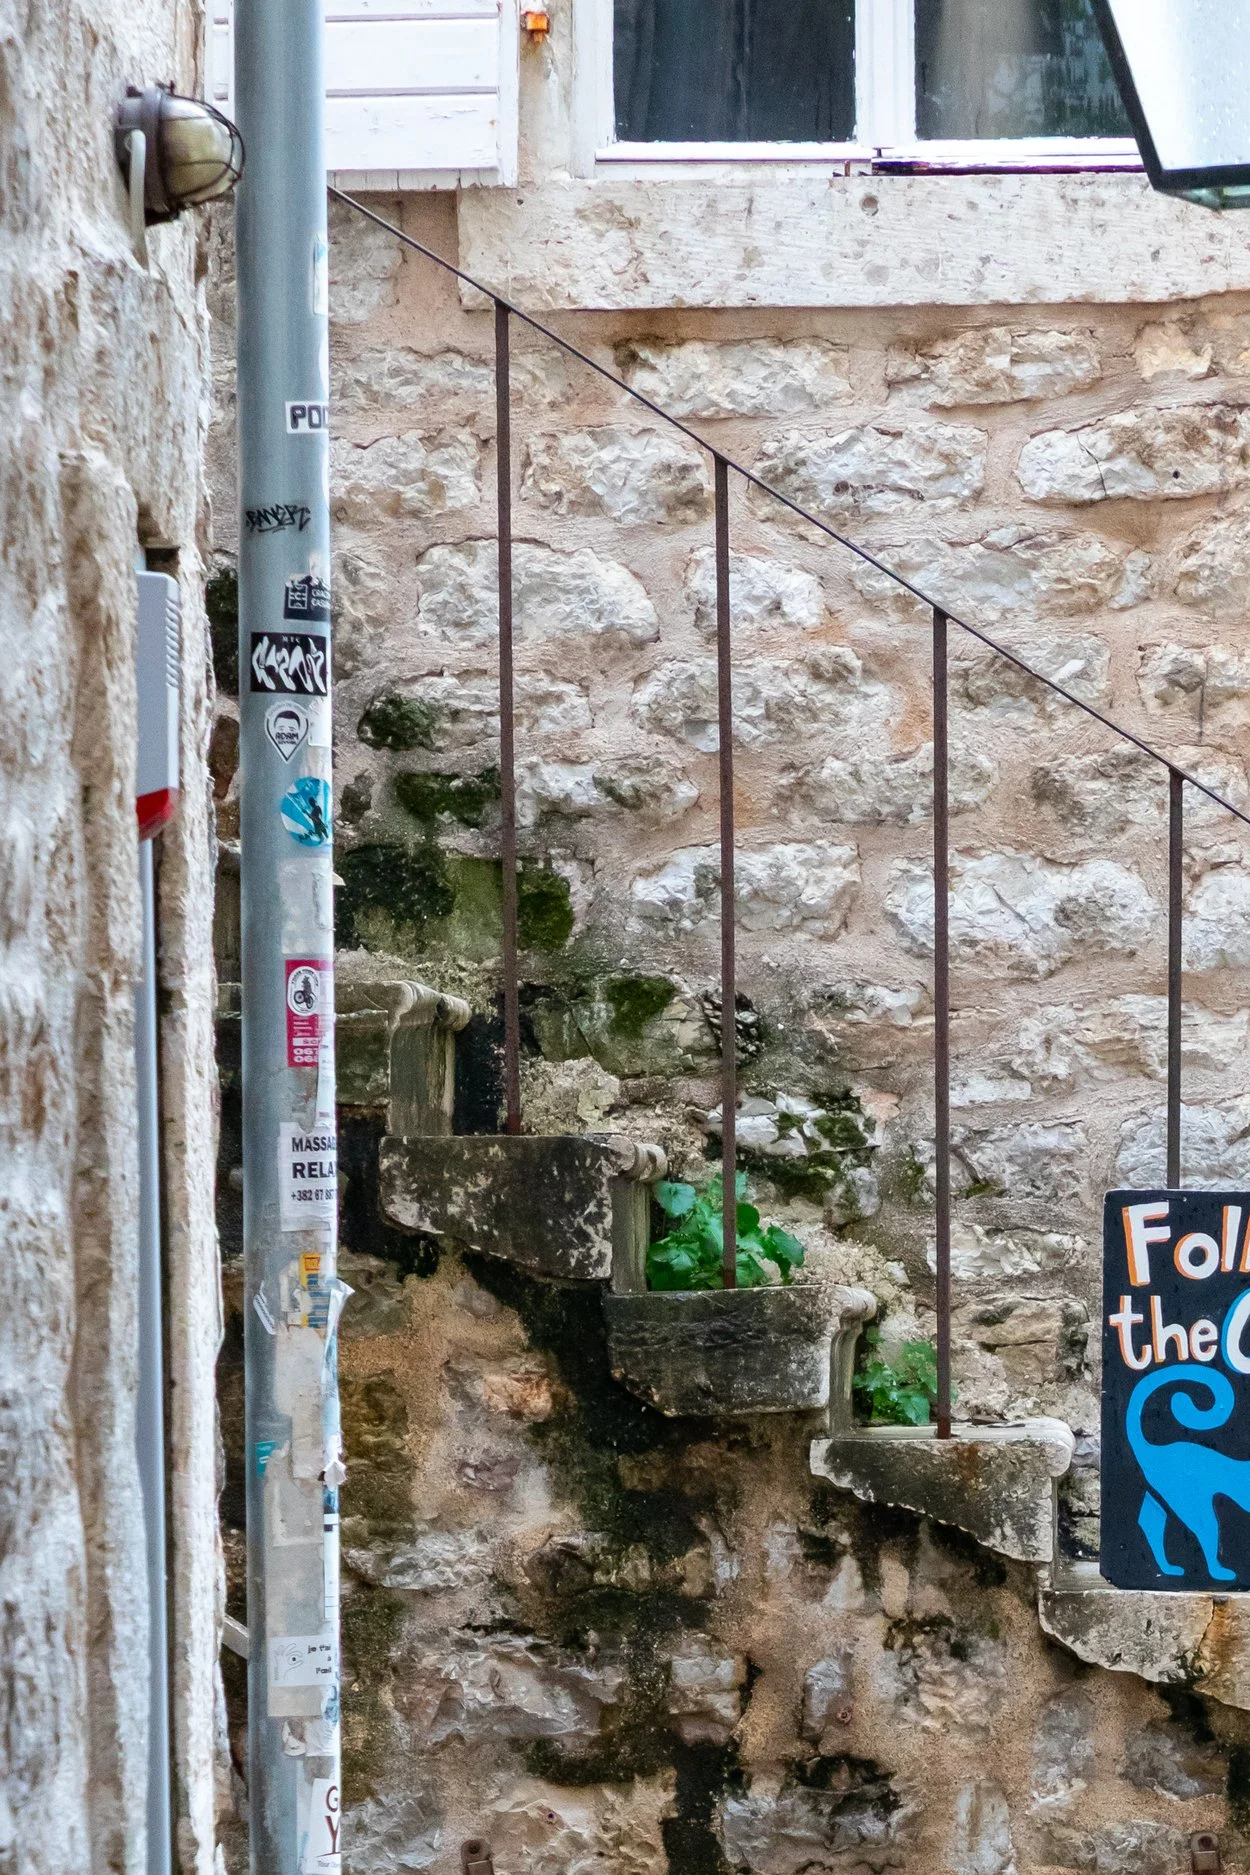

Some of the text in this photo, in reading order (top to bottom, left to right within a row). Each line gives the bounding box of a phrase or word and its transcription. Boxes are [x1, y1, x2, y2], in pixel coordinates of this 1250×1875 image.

[290, 405, 328, 430] PO
[292, 1161, 335, 1179] RELA
[1108, 1295, 1218, 1371] the
